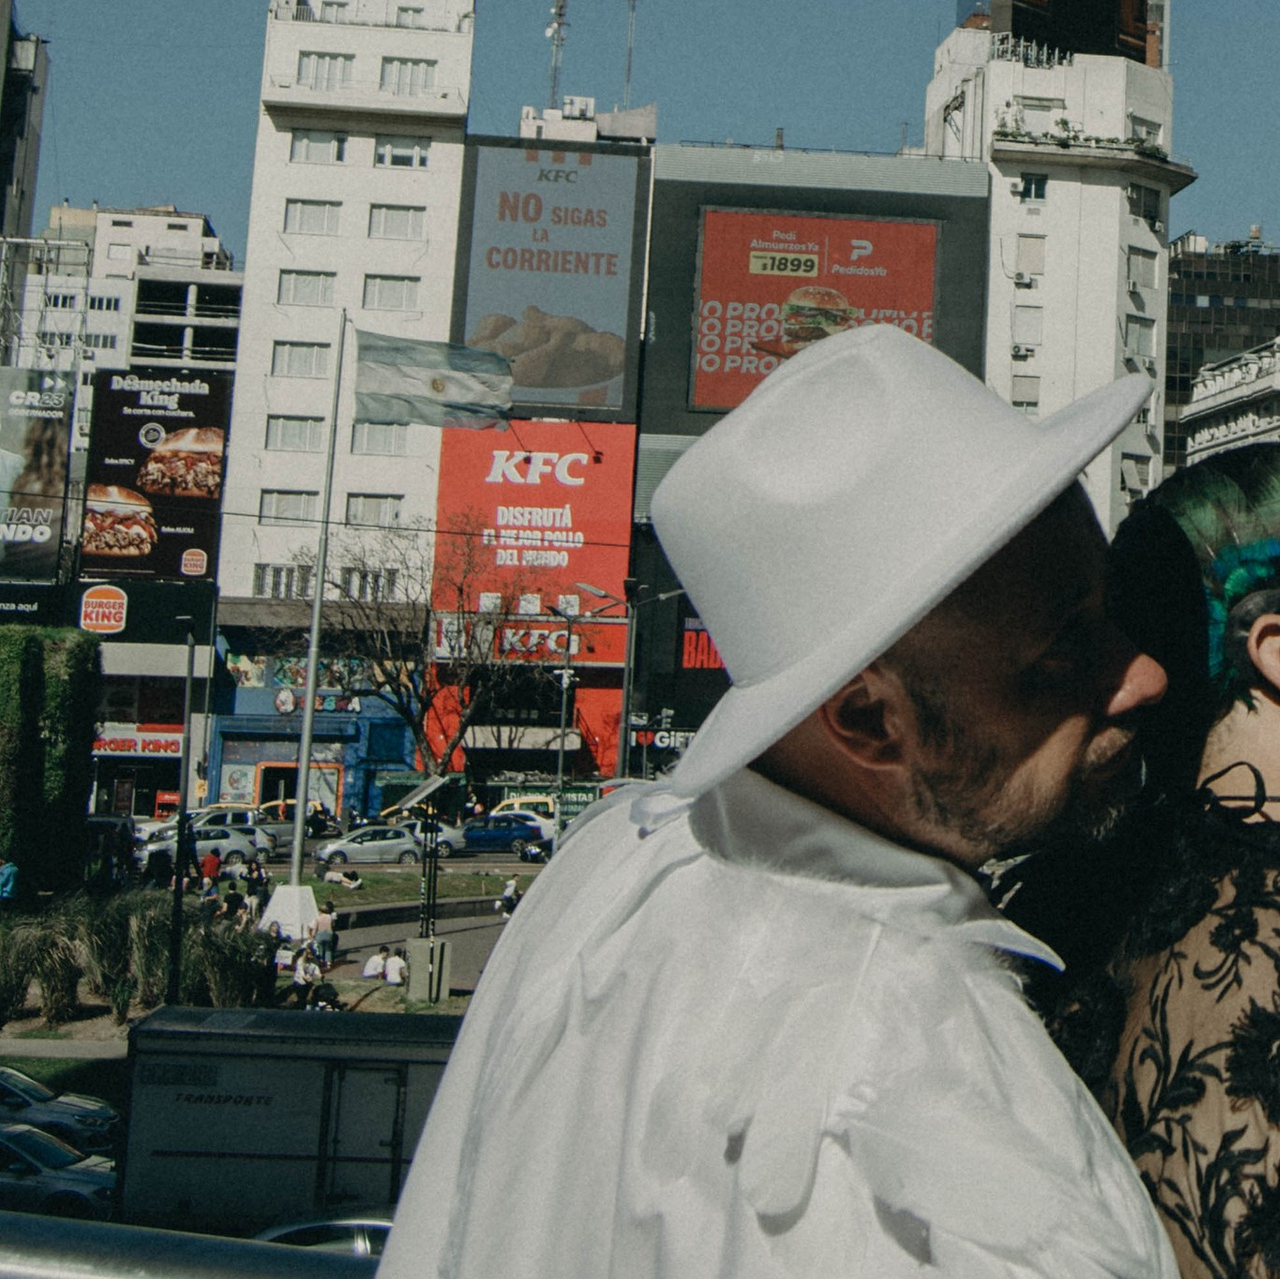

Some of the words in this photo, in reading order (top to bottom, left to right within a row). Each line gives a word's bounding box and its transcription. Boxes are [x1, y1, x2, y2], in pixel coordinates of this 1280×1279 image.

[537, 169, 578, 184] KFC
[498, 191, 543, 224] NO
[552, 205, 608, 228] SIGAS
[531, 227, 550, 243] LA
[485, 246, 619, 276] CORRIENTE
[111, 375, 209, 394] Desmechada
[9, 390, 65, 408] CR23
[140, 391, 179, 410] King
[485, 450, 588, 486] KFC
[497, 504, 572, 528] DISFRUTÁ
[500, 529, 542, 547] MEJOR
[543, 531, 584, 549] POLLO
[496, 549, 519, 565] DEL
[522, 550, 568, 568] MUNDO
[17, 601, 39, 613] aquí
[84, 601, 125, 610] BURGER
[83, 610, 124, 623] KING
[141, 739, 180, 753] KING
[175, 1092, 273, 1107] TRANSPORTE
